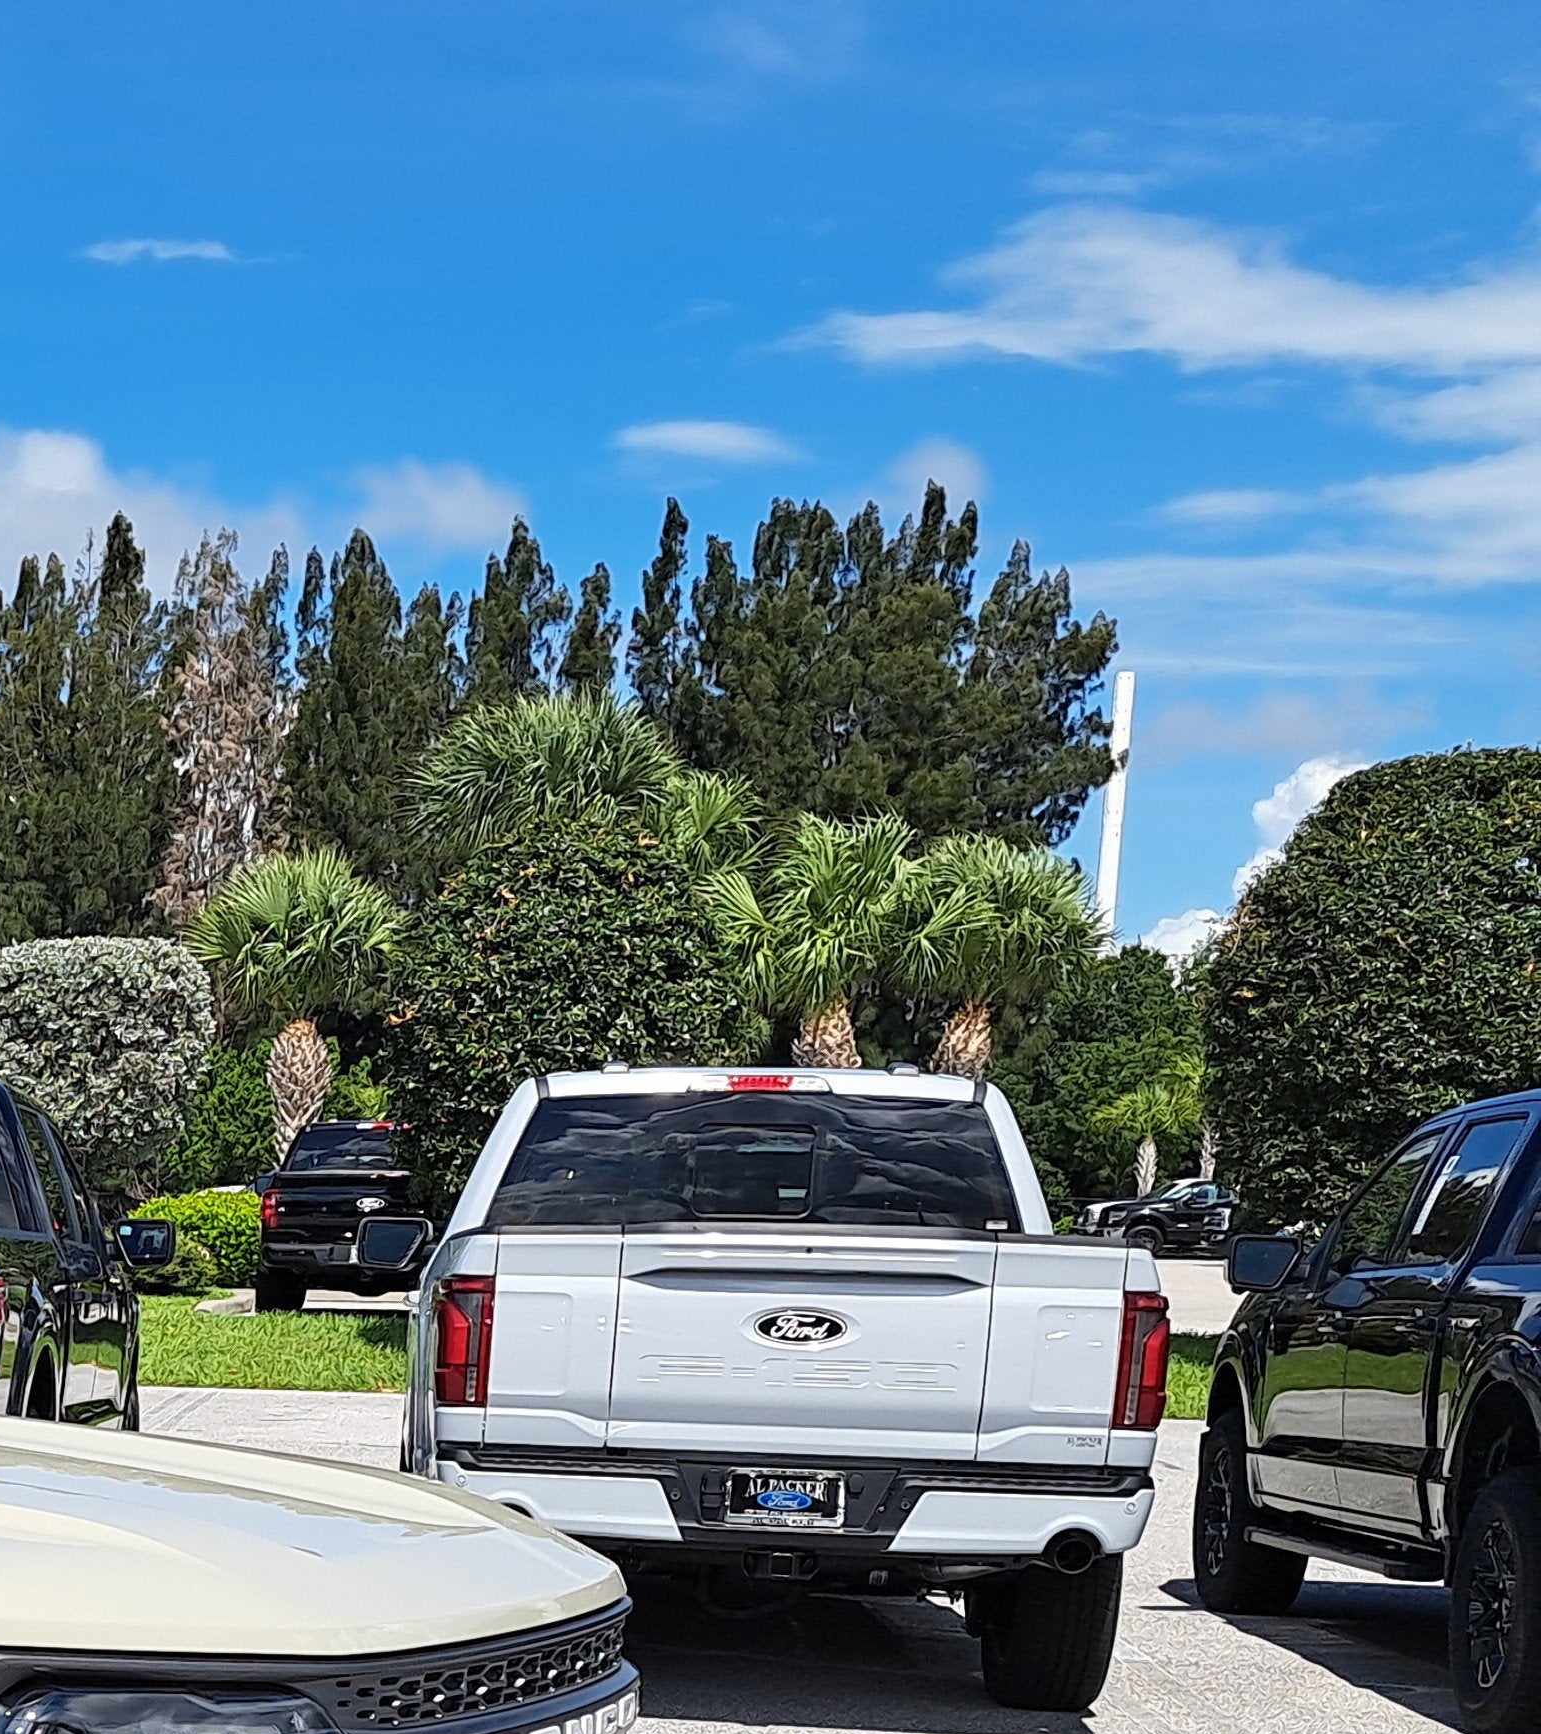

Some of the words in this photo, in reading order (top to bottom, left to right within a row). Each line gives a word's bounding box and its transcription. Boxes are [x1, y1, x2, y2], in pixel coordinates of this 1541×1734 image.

[770, 1312, 829, 1341] Ford
[636, 1354, 959, 1392] F-150
[743, 1478, 766, 1498] AL
[769, 1479, 829, 1503] PACKER
